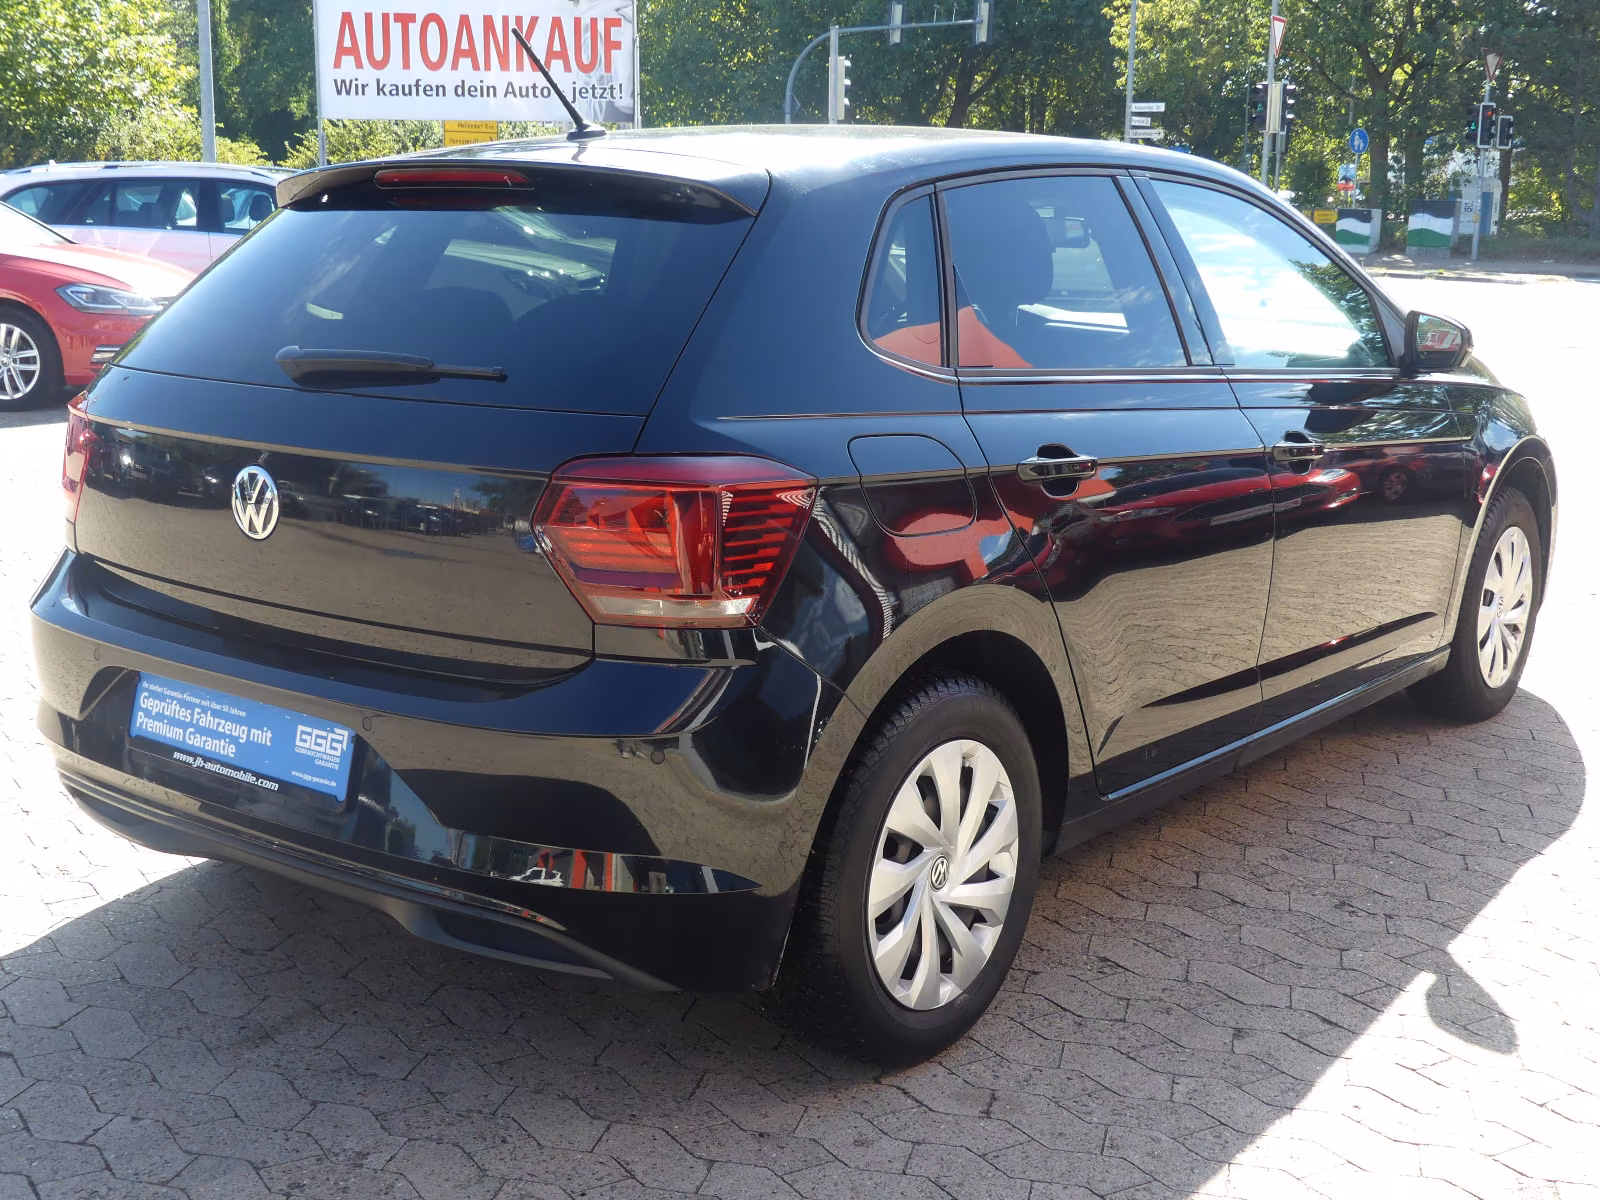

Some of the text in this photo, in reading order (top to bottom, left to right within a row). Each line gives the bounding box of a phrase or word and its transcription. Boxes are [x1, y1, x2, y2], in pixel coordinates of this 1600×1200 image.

[333, 11, 622, 74] AUTOANKAUF
[333, 78, 624, 104] Wir kaufen dein Auto jetzt!
[232, 465, 279, 539] VW
[139, 691, 273, 747] Geprüftes Fahrzeug mit
[229, 706, 246, 717] Jahren
[136, 711, 236, 758] Premium Garantie
[295, 724, 345, 757] GGG
[173, 750, 279, 791] www.jh-automobile.com
[294, 746, 341, 764] GEBRAUCHTWAGEN
[314, 758, 340, 771] GARANTIE
